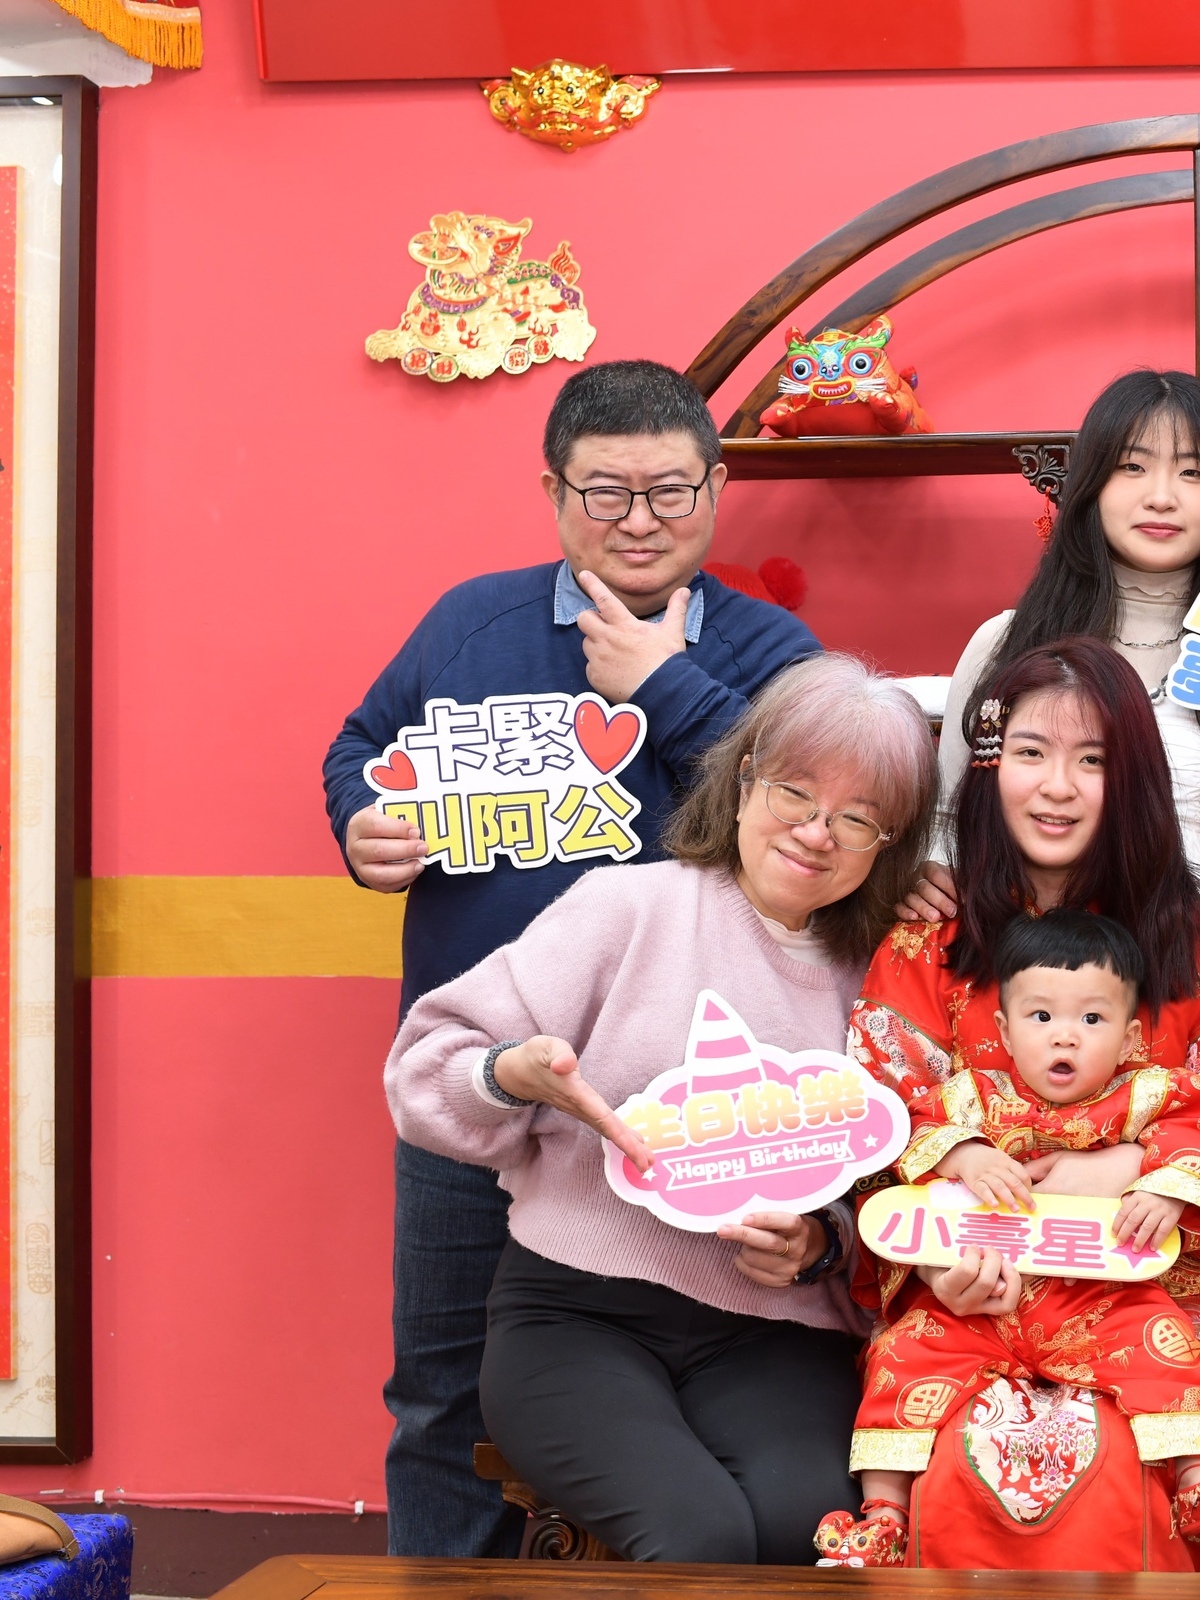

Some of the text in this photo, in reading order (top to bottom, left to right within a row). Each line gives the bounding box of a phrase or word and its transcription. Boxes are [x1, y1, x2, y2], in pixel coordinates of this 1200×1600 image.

[405, 700, 574, 782] 卡緊
[624, 1070, 867, 1150] 生日快樂
[674, 1138, 848, 1180] Happy Birthday
[878, 1207, 1106, 1269] 小壽星
